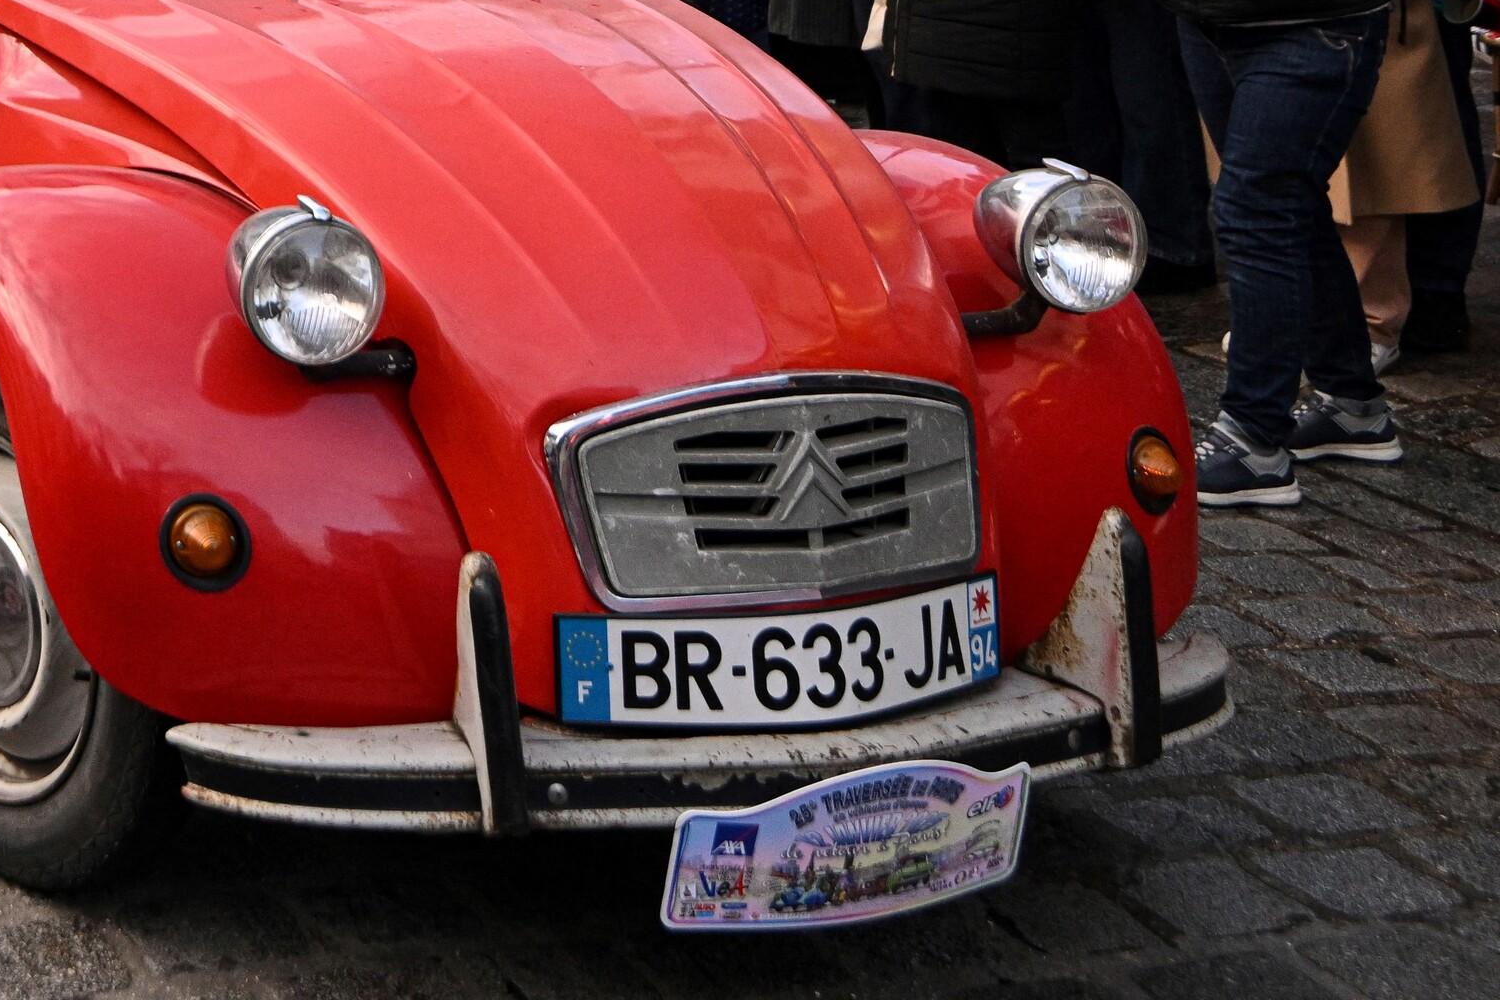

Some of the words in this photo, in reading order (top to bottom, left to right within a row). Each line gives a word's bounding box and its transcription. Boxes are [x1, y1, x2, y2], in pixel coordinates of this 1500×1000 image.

[621, 598, 966, 711] BR-633-JA
[971, 630, 996, 671] 94
[577, 681, 592, 704] F
[967, 791, 998, 818] elf
[712, 840, 746, 856] AXA
